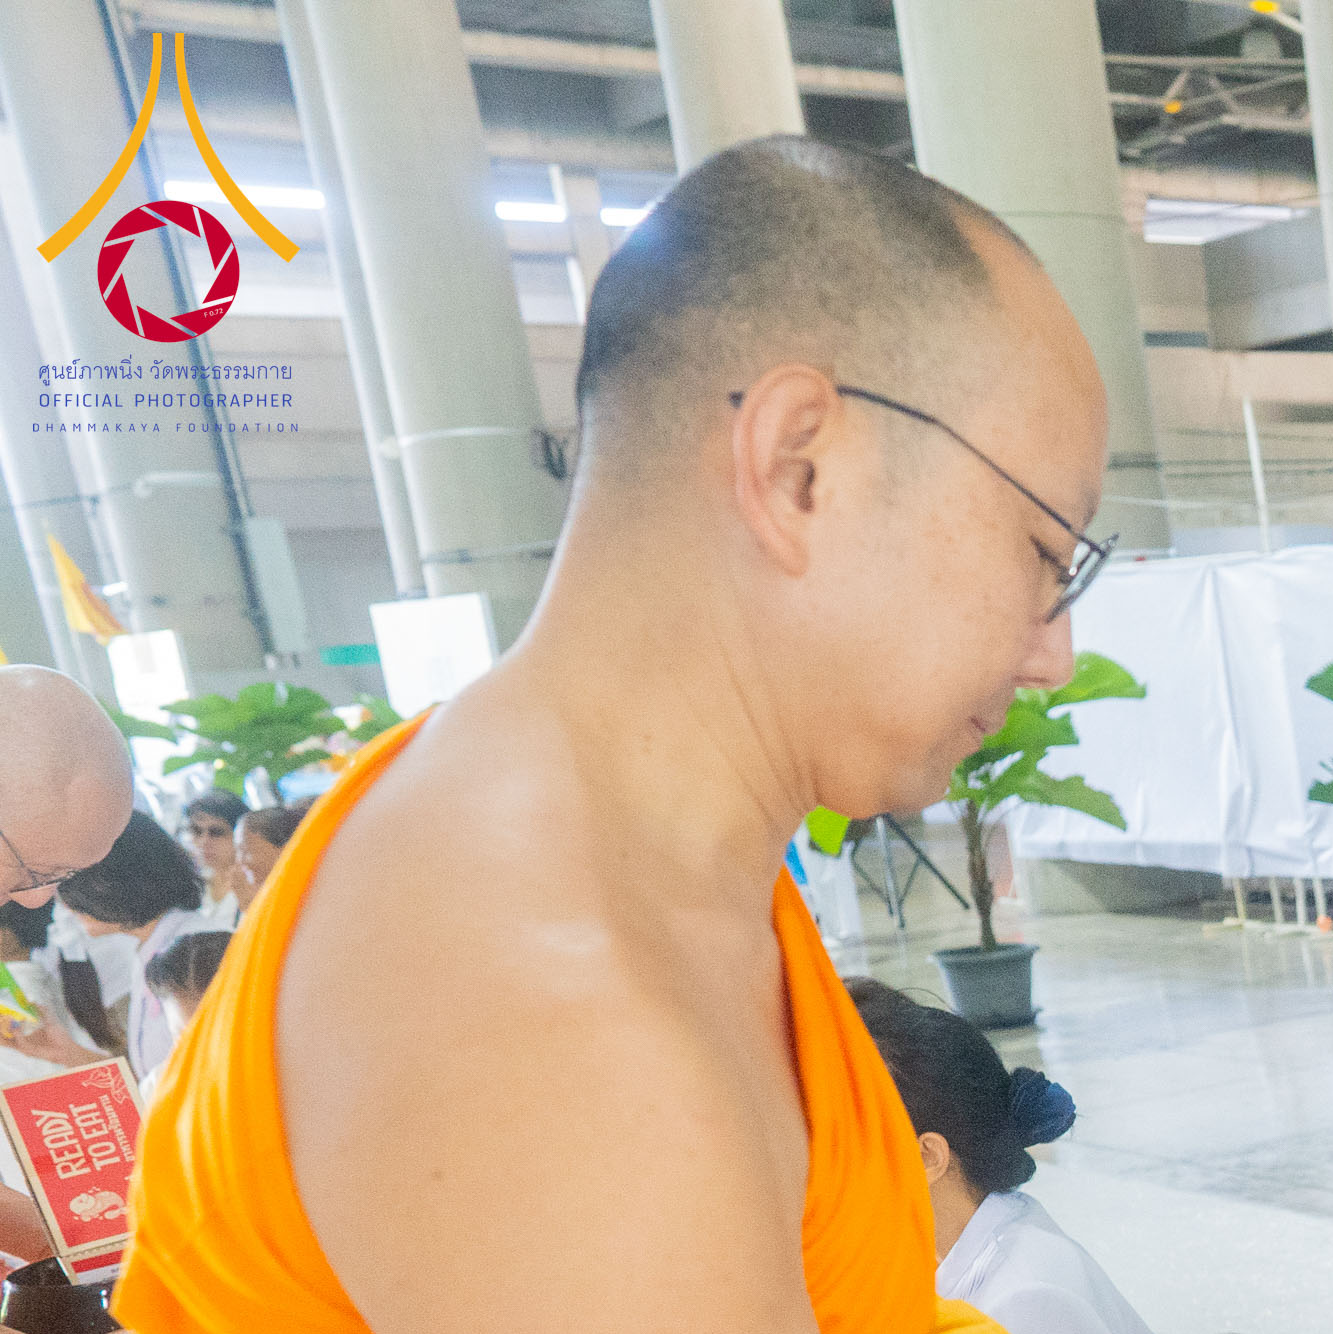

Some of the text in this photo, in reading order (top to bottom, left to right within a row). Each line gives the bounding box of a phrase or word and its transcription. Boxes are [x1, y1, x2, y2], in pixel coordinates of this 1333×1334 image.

[31, 1108, 92, 1180] READY
[68, 1102, 121, 1172] TO EAT
